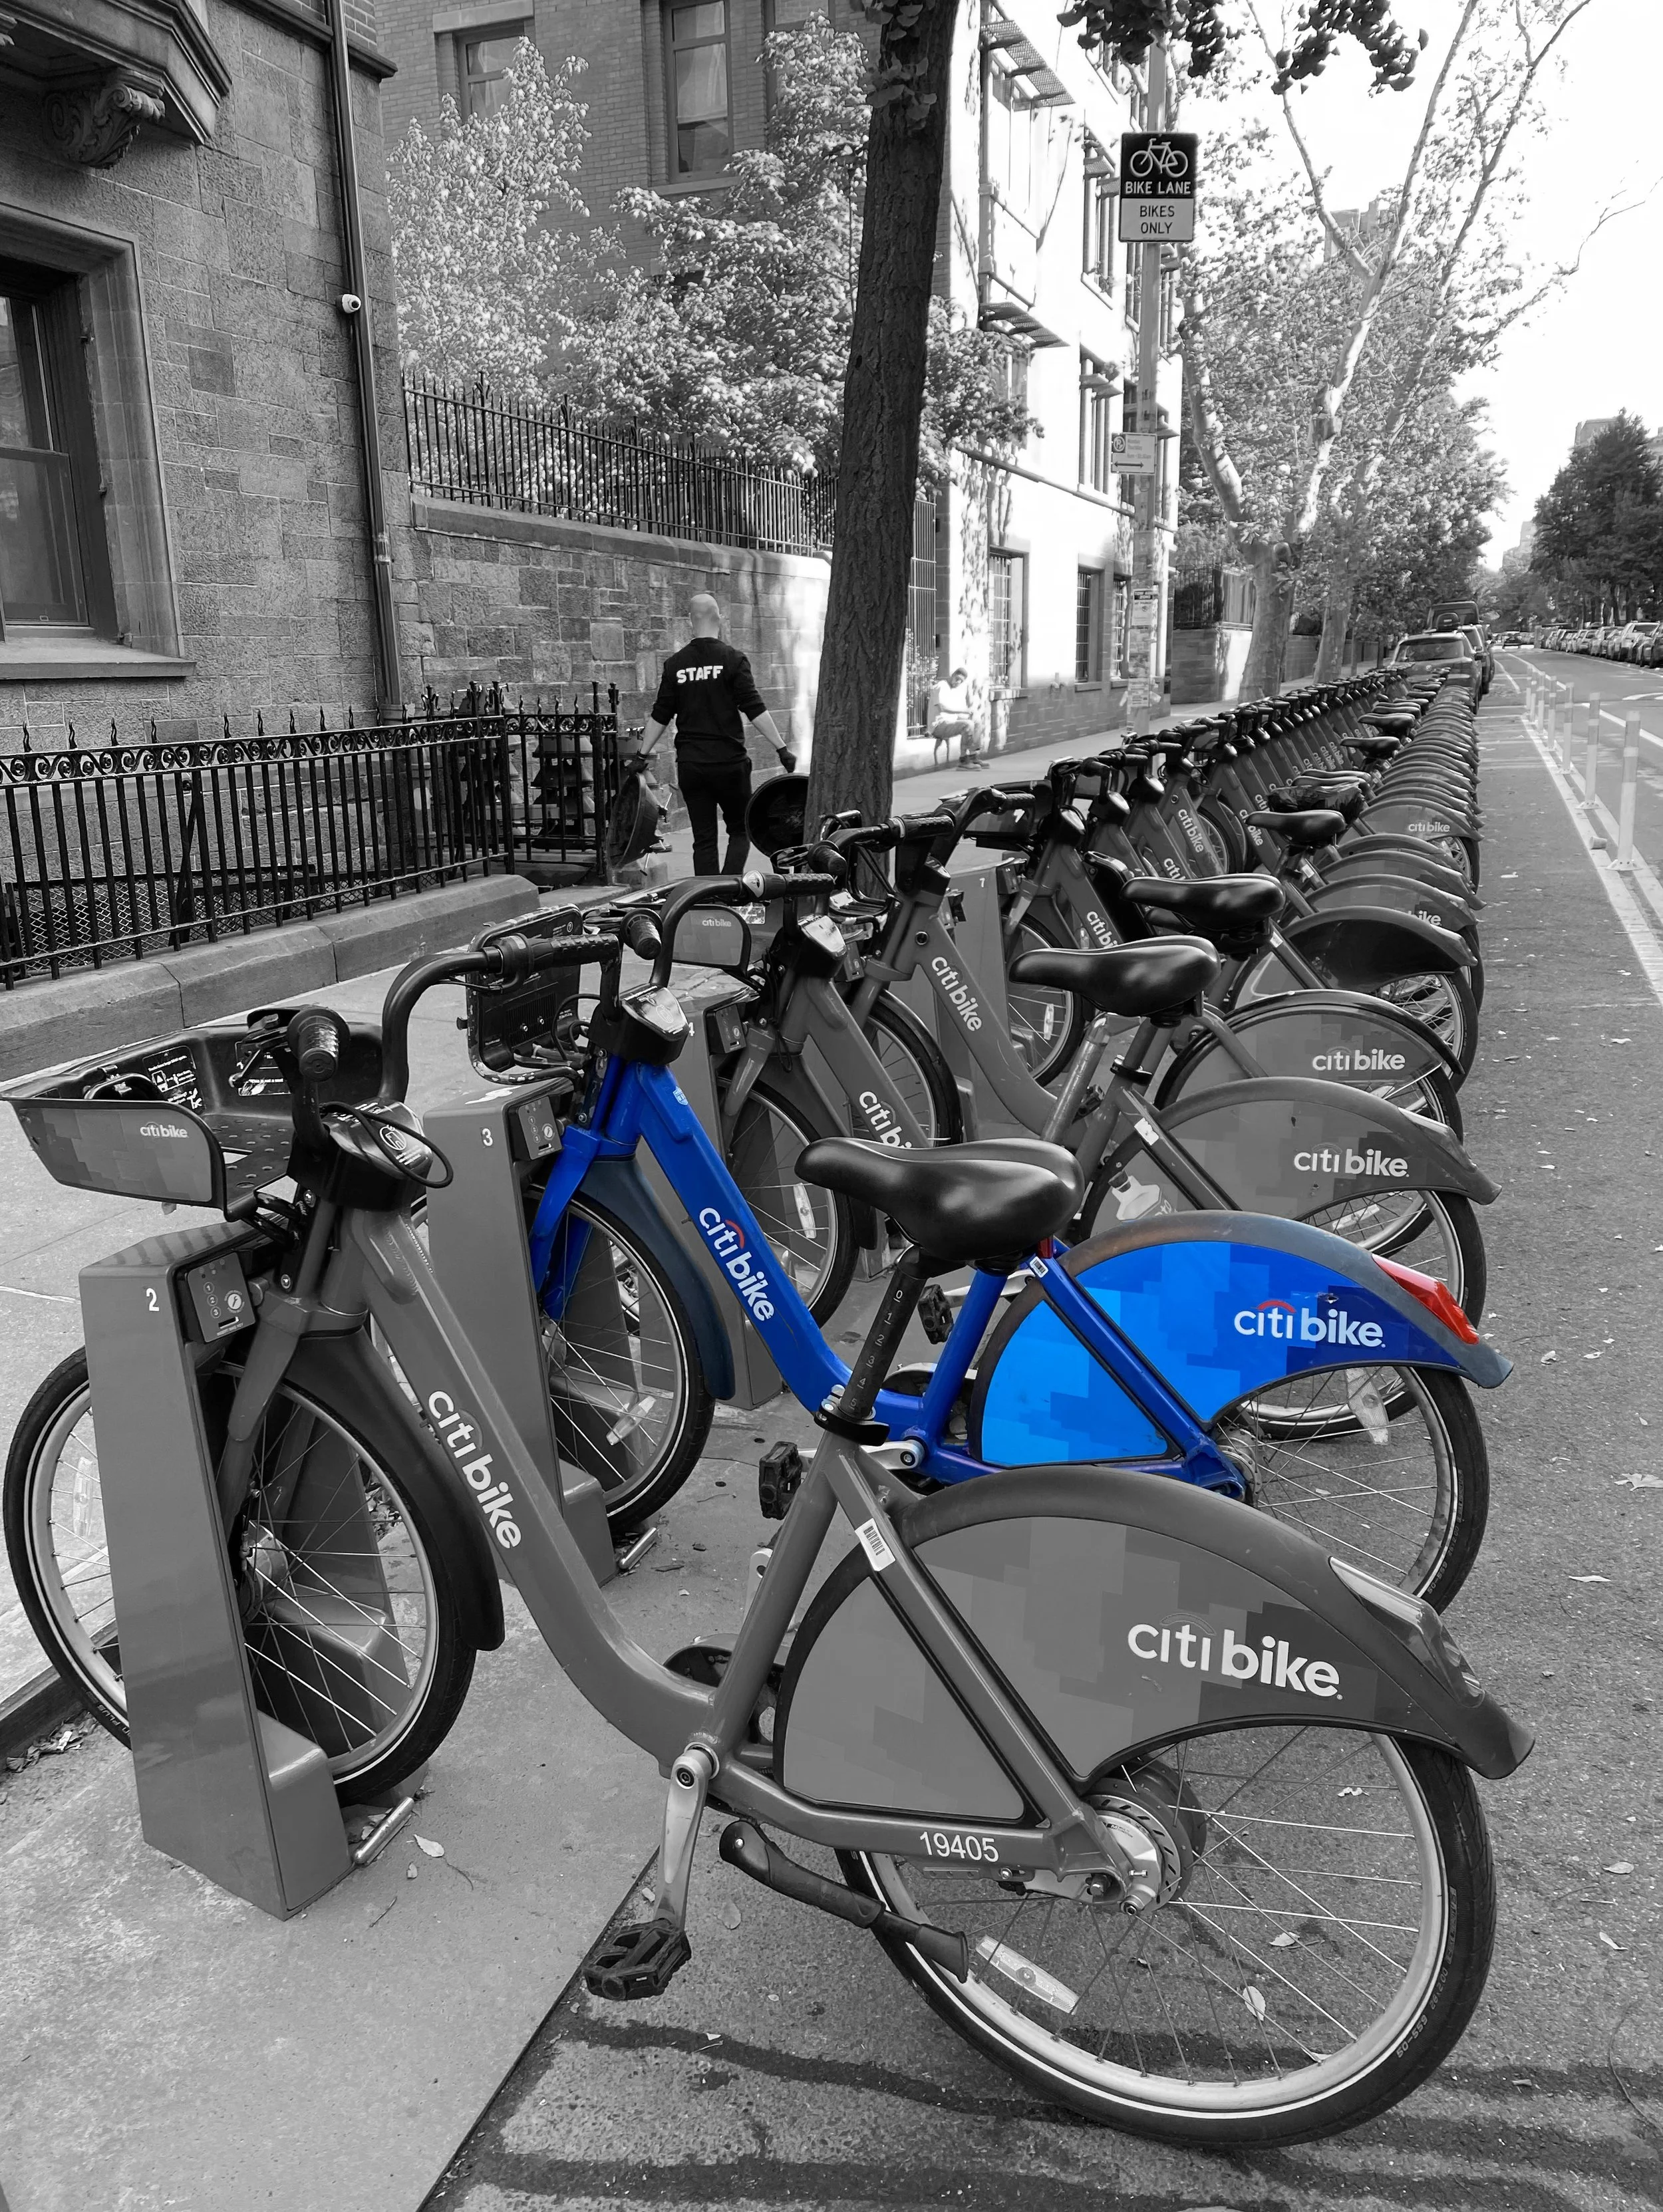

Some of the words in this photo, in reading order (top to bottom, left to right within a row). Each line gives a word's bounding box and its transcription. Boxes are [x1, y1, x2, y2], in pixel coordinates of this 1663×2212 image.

[1125, 181, 1152, 194] BIKE
[1157, 181, 1191, 194] LANE
[1139, 205, 1175, 217] BIKES
[1141, 221, 1173, 233] ONLY
[676, 665, 724, 684] STAFF
[1427, 821, 1450, 832] bike
[979, 878, 985, 887] 7
[1098, 931, 1118, 948] bi
[949, 984, 983, 1032] bike
[1354, 1049, 1406, 1070] bike
[160, 1124, 188, 1138] bike
[482, 1128, 493, 1147] 3
[1345, 1149, 1408, 1177] bike
[726, 1251, 774, 1321] bike
[146, 1288, 160, 1311] 2
[887, 1312, 893, 1321] 1
[1301, 1308, 1384, 1348] bike
[877, 1334, 885, 1343] 2
[868, 1355, 875, 1365] 3
[850, 1398, 857, 1407] 5
[464, 1453, 522, 1550] bike
[1223, 1629, 1340, 1698] bike
[919, 1830, 999, 1862] 19405
